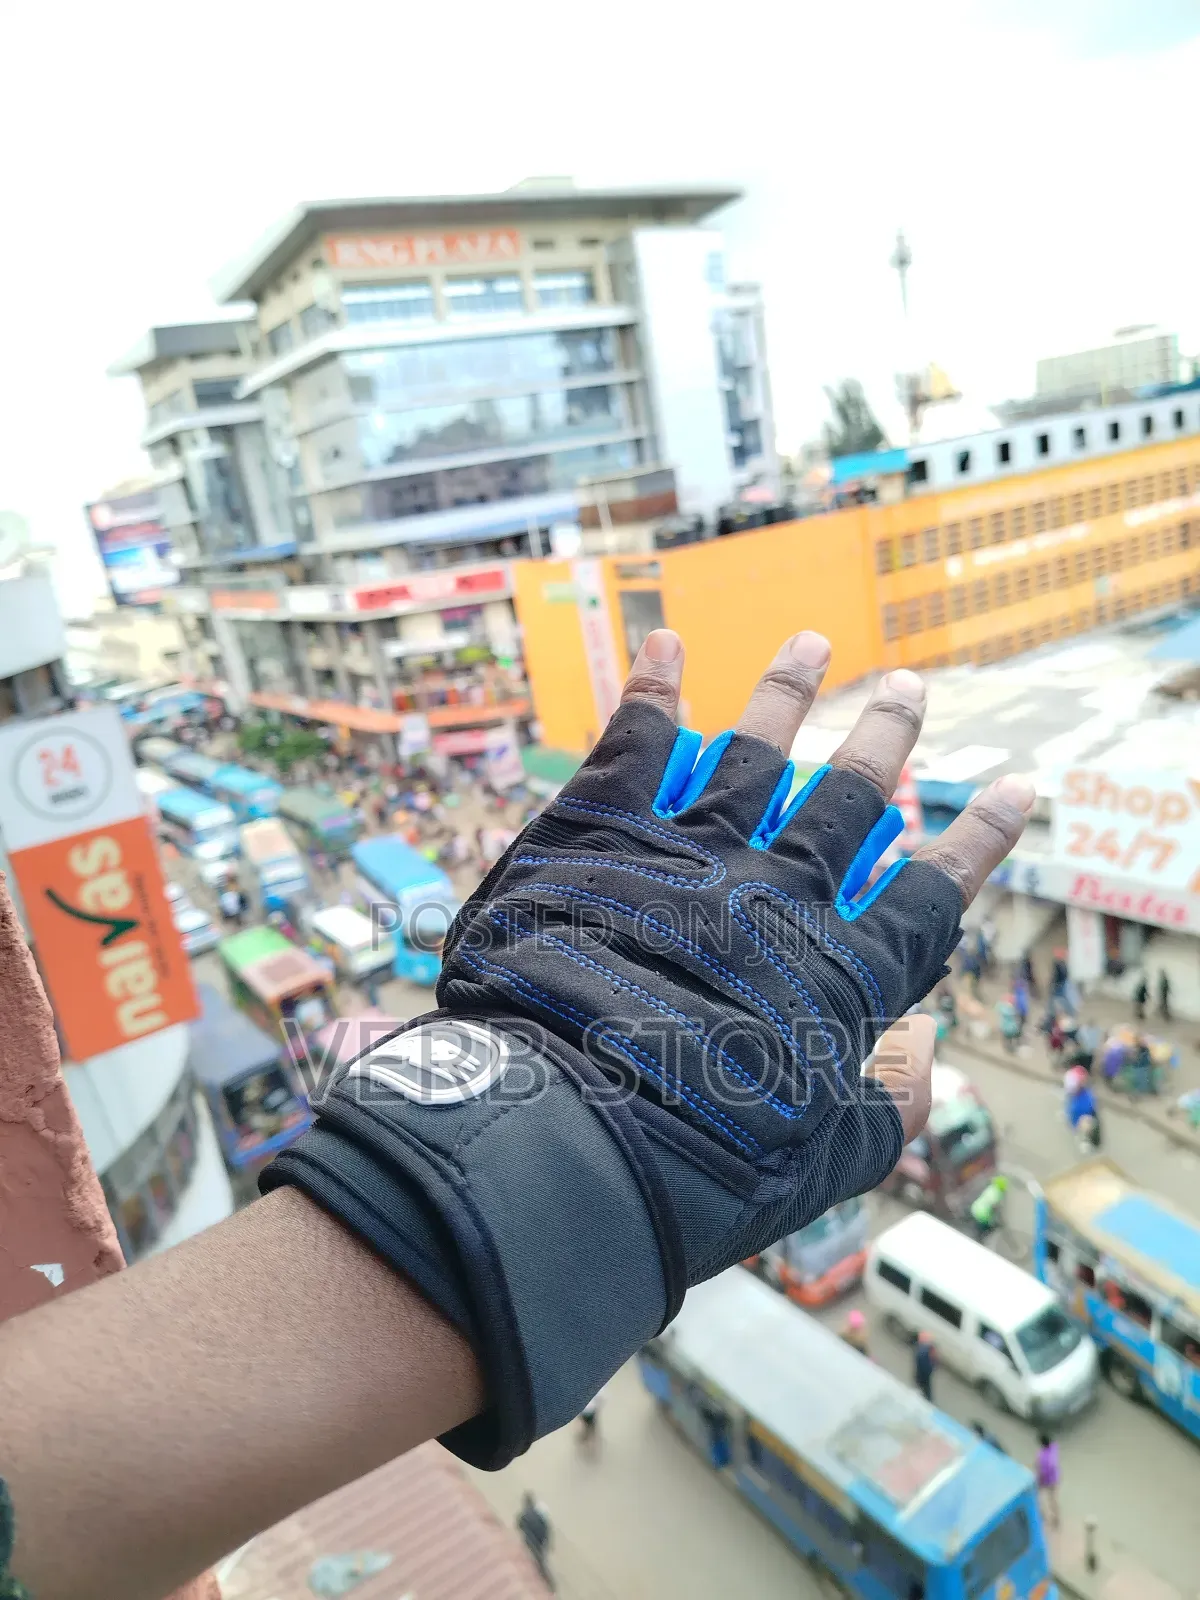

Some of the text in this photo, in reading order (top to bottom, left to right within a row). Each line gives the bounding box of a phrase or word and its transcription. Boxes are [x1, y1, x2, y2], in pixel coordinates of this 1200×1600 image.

[38, 745, 81, 787] 24
[1061, 769, 1191, 827] Shop
[1065, 821, 1182, 874] 24/7
[43, 833, 169, 1037] naivas
